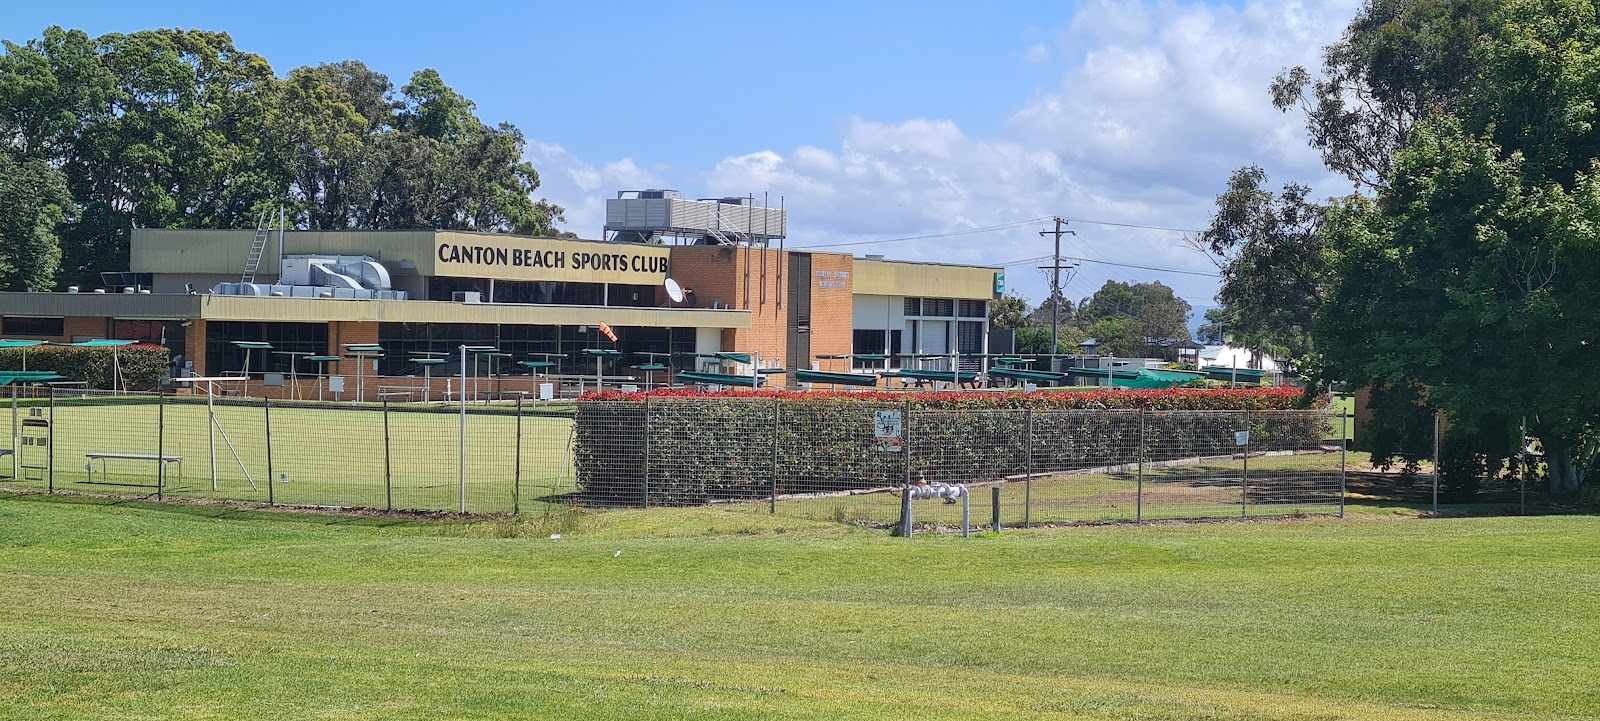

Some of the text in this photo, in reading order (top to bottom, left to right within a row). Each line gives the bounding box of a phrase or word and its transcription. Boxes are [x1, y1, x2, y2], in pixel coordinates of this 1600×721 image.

[438, 243, 669, 274] CANTON BEACH SPORTS CLUB
